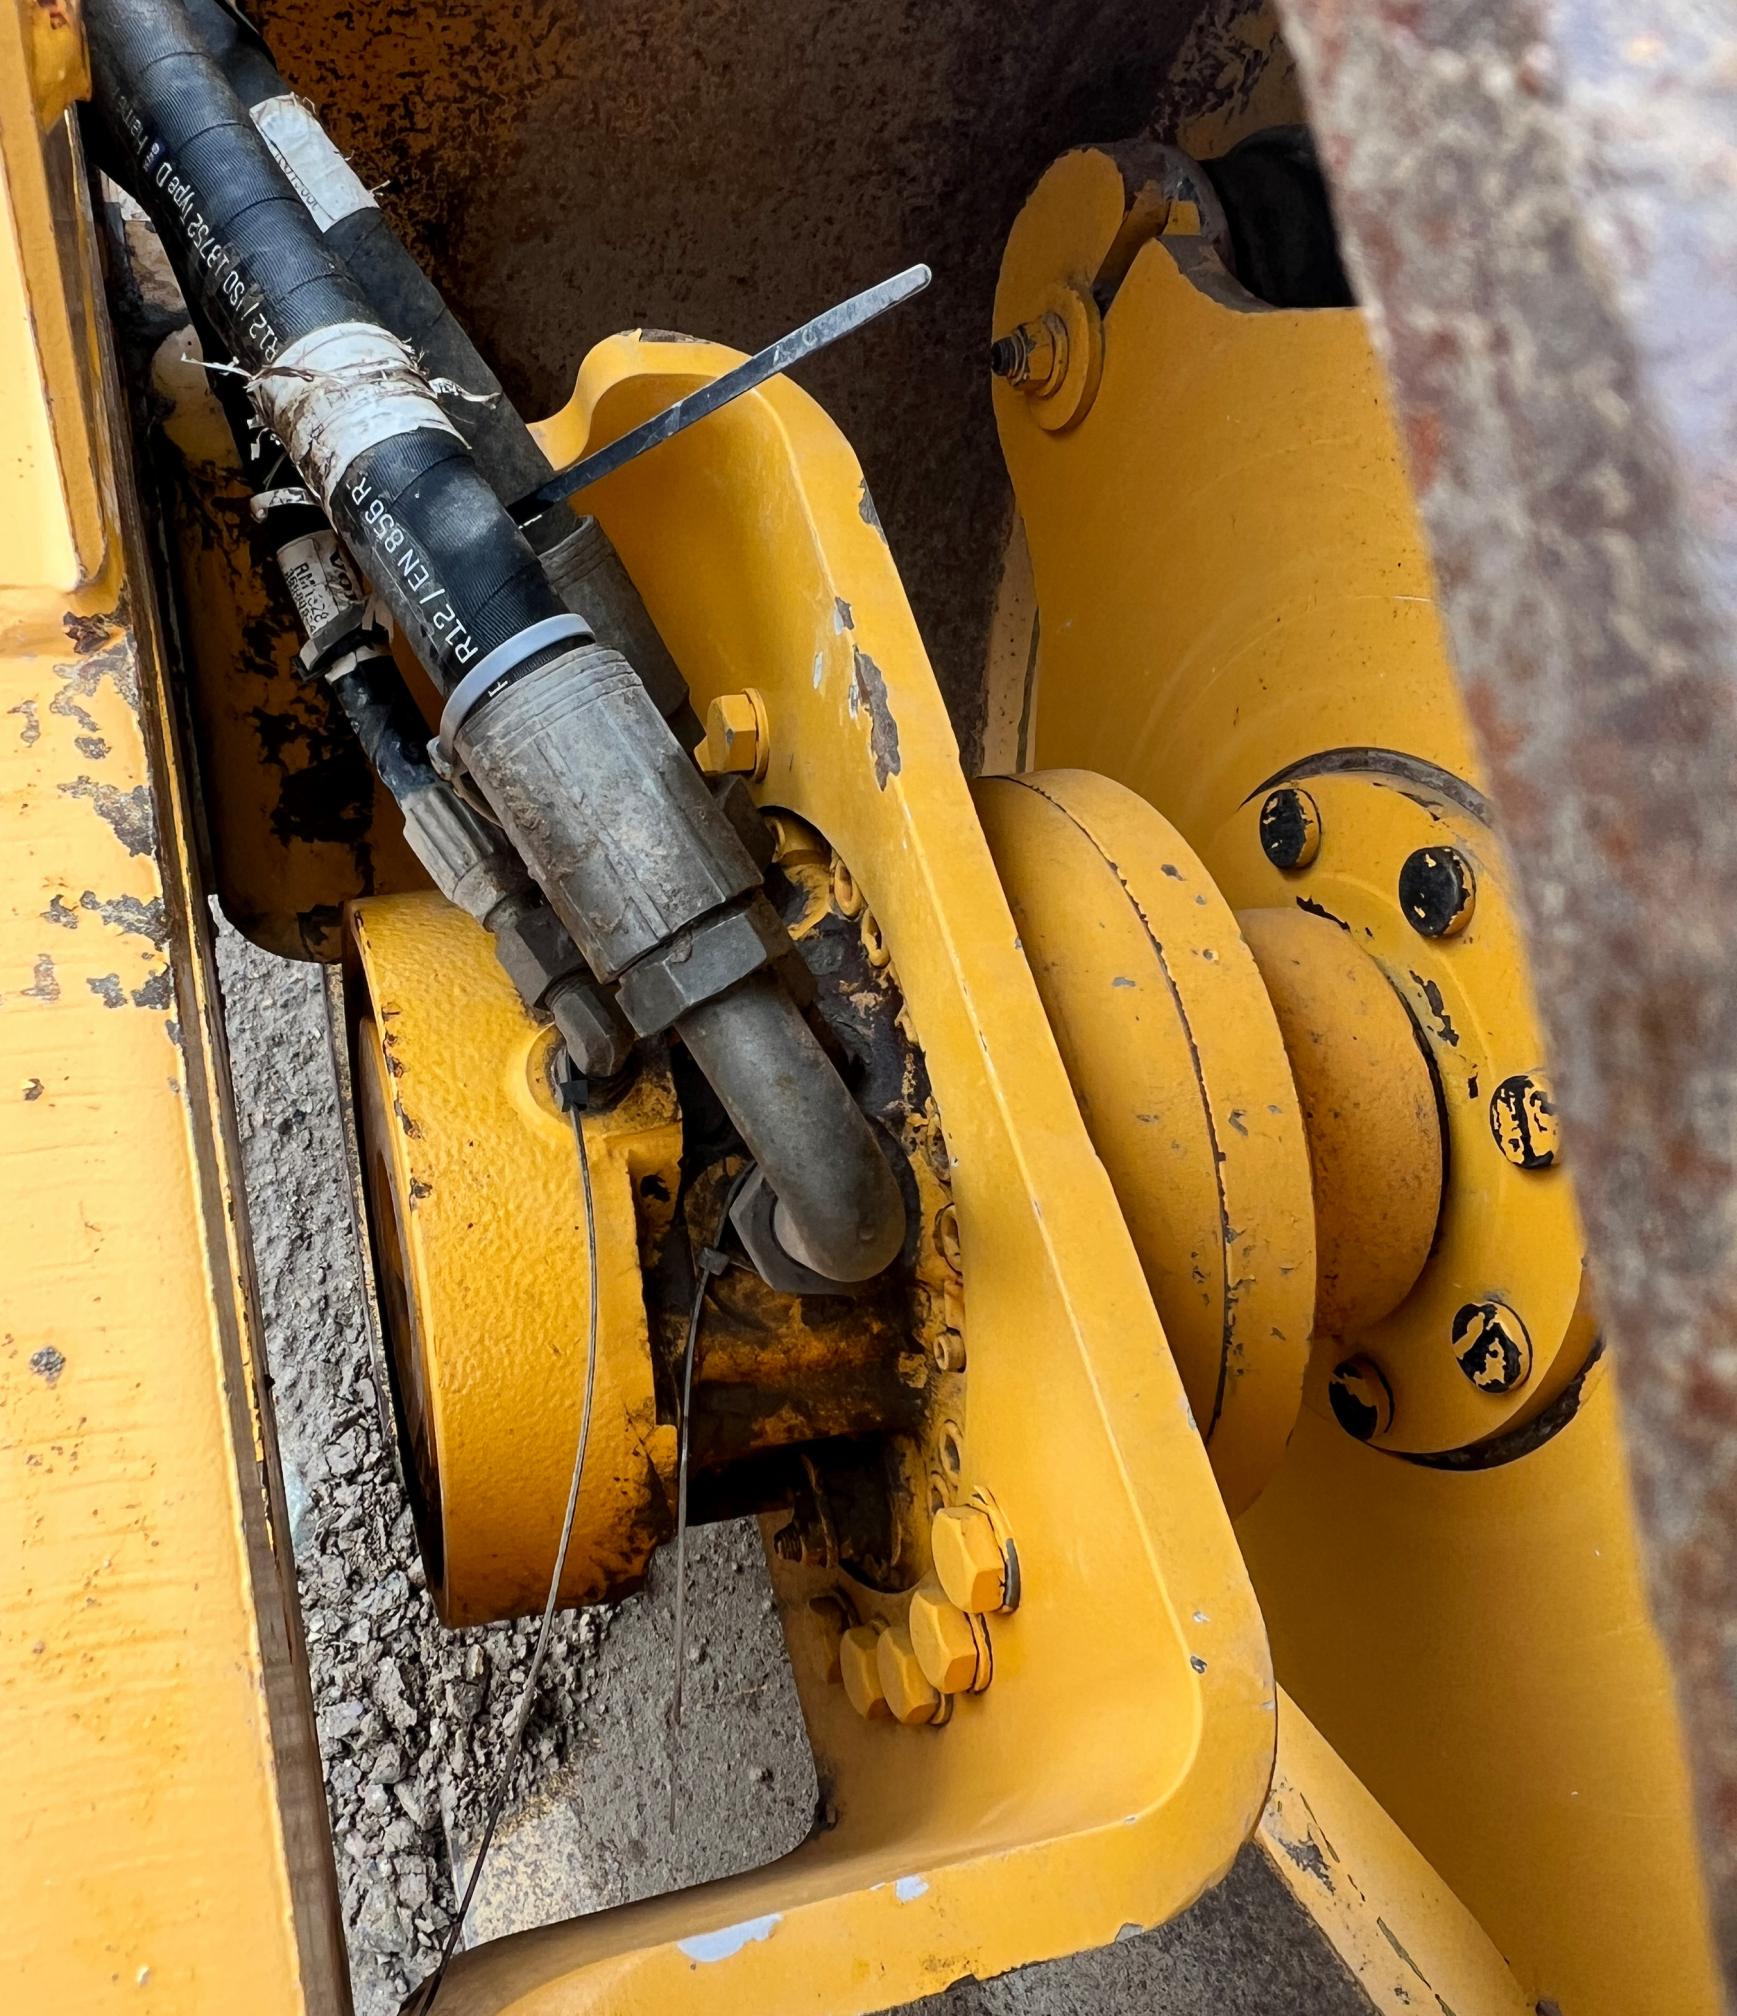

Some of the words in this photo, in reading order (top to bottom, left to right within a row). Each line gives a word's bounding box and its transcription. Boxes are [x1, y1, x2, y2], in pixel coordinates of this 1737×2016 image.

[156, 161, 173, 188] D
[168, 176, 195, 226] Type
[187, 213, 229, 276] 18752
[223, 270, 245, 311] ISO
[249, 312, 278, 362] R12
[365, 499, 405, 553] 856
[397, 548, 430, 587] EN
[419, 588, 446, 604] /
[433, 603, 479, 664] R12
